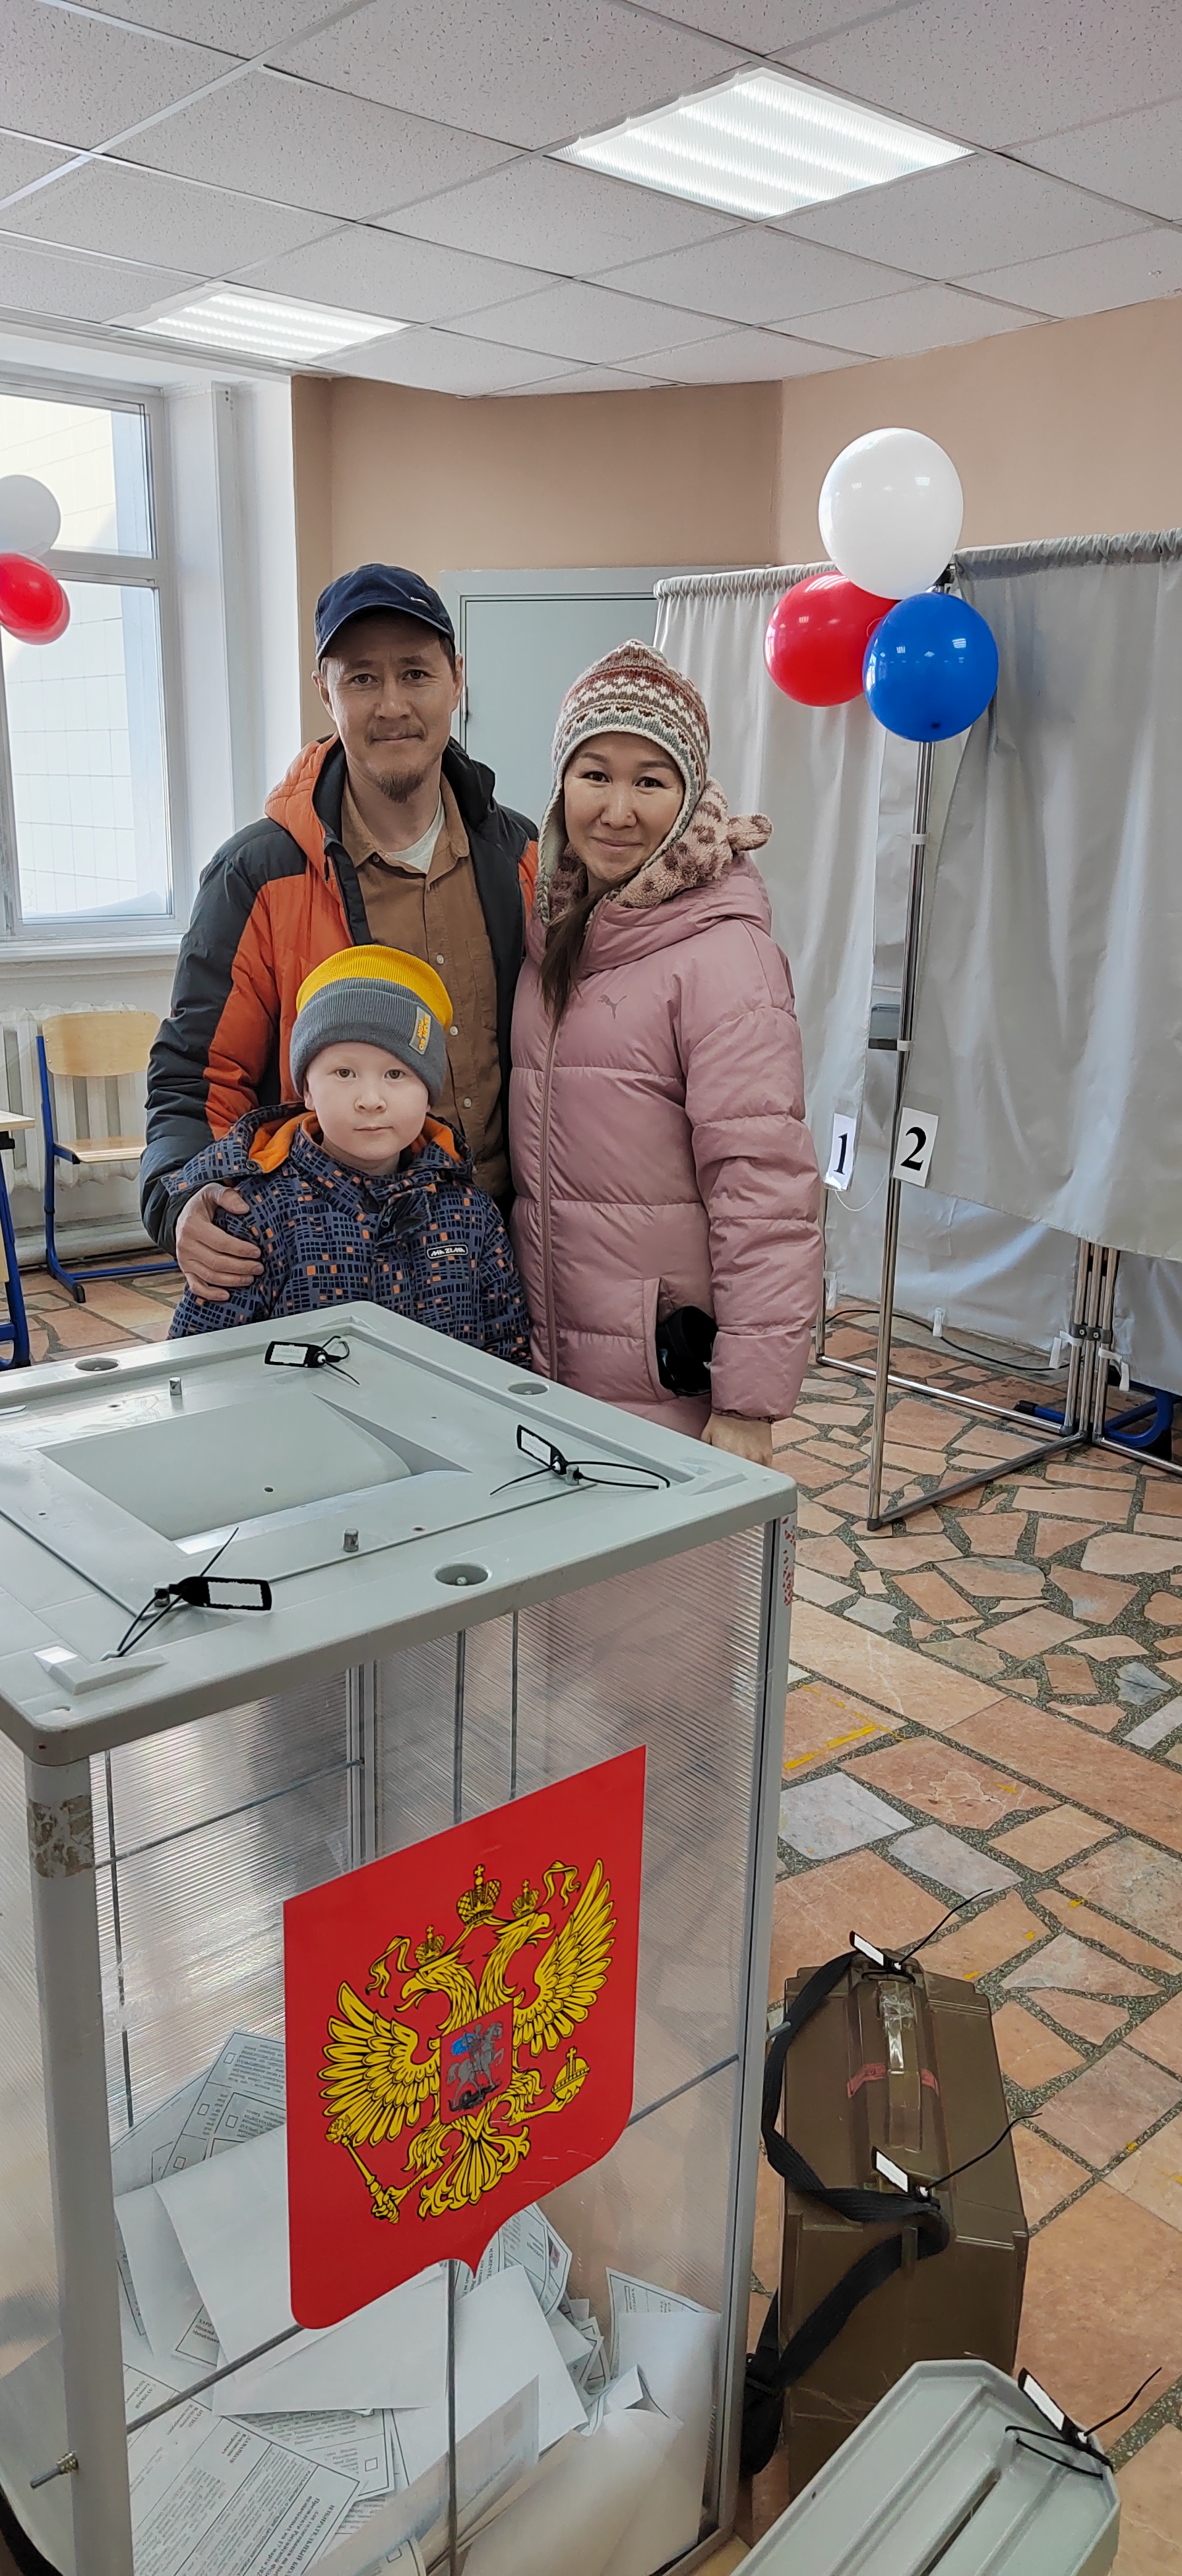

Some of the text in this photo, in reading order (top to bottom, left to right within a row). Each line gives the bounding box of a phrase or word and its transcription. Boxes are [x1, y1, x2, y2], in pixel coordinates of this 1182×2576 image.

[419, 1038, 425, 1050] OR
[833, 1132, 848, 1175] 1
[900, 1126, 927, 1171] 2
[296, 2503, 335, 2561] ИЗБИРАТЕЛЬНЫЙ
